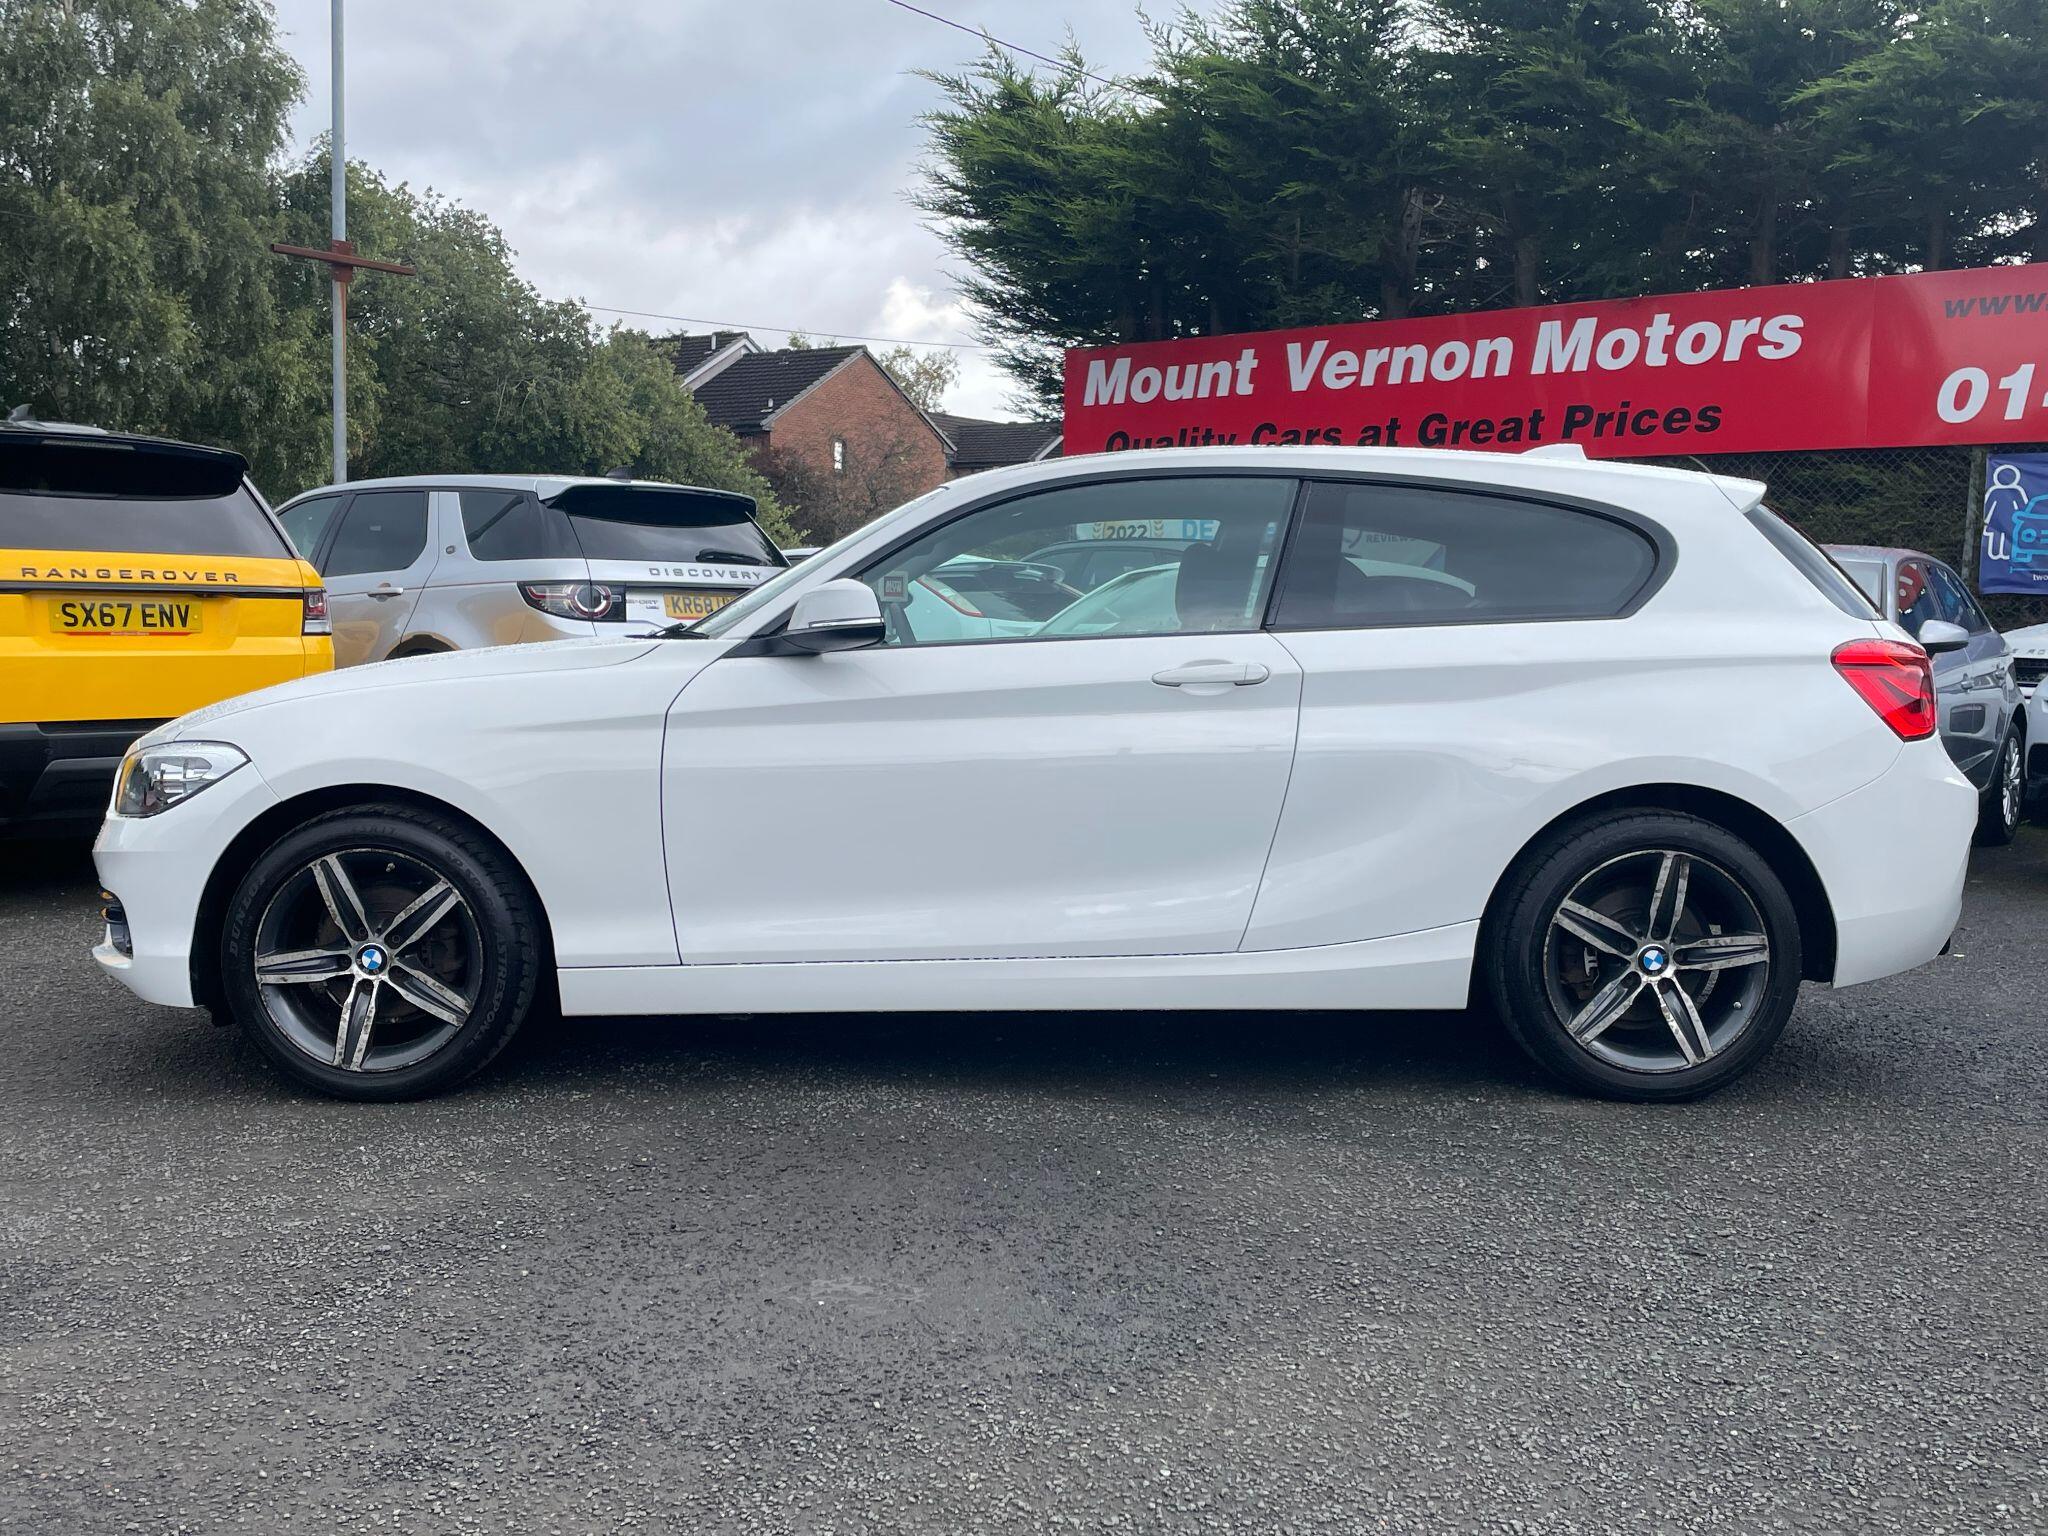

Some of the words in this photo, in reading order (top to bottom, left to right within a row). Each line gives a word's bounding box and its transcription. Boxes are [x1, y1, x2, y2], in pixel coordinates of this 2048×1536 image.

[1083, 348, 1258, 407] Mount
[1286, 330, 1514, 392] Vernon
[1530, 313, 1804, 375] Motors
[1936, 363, 2048, 423] 01
[1251, 422, 1342, 447] Cars
[1357, 417, 1402, 447] at
[1417, 408, 1546, 447] Great
[1561, 400, 1723, 441] Prices
[1107, 525, 1149, 540] 2022
[649, 567, 761, 580] DISCOVERY
[61, 602, 132, 628] SX67
[141, 603, 190, 628] ENV
